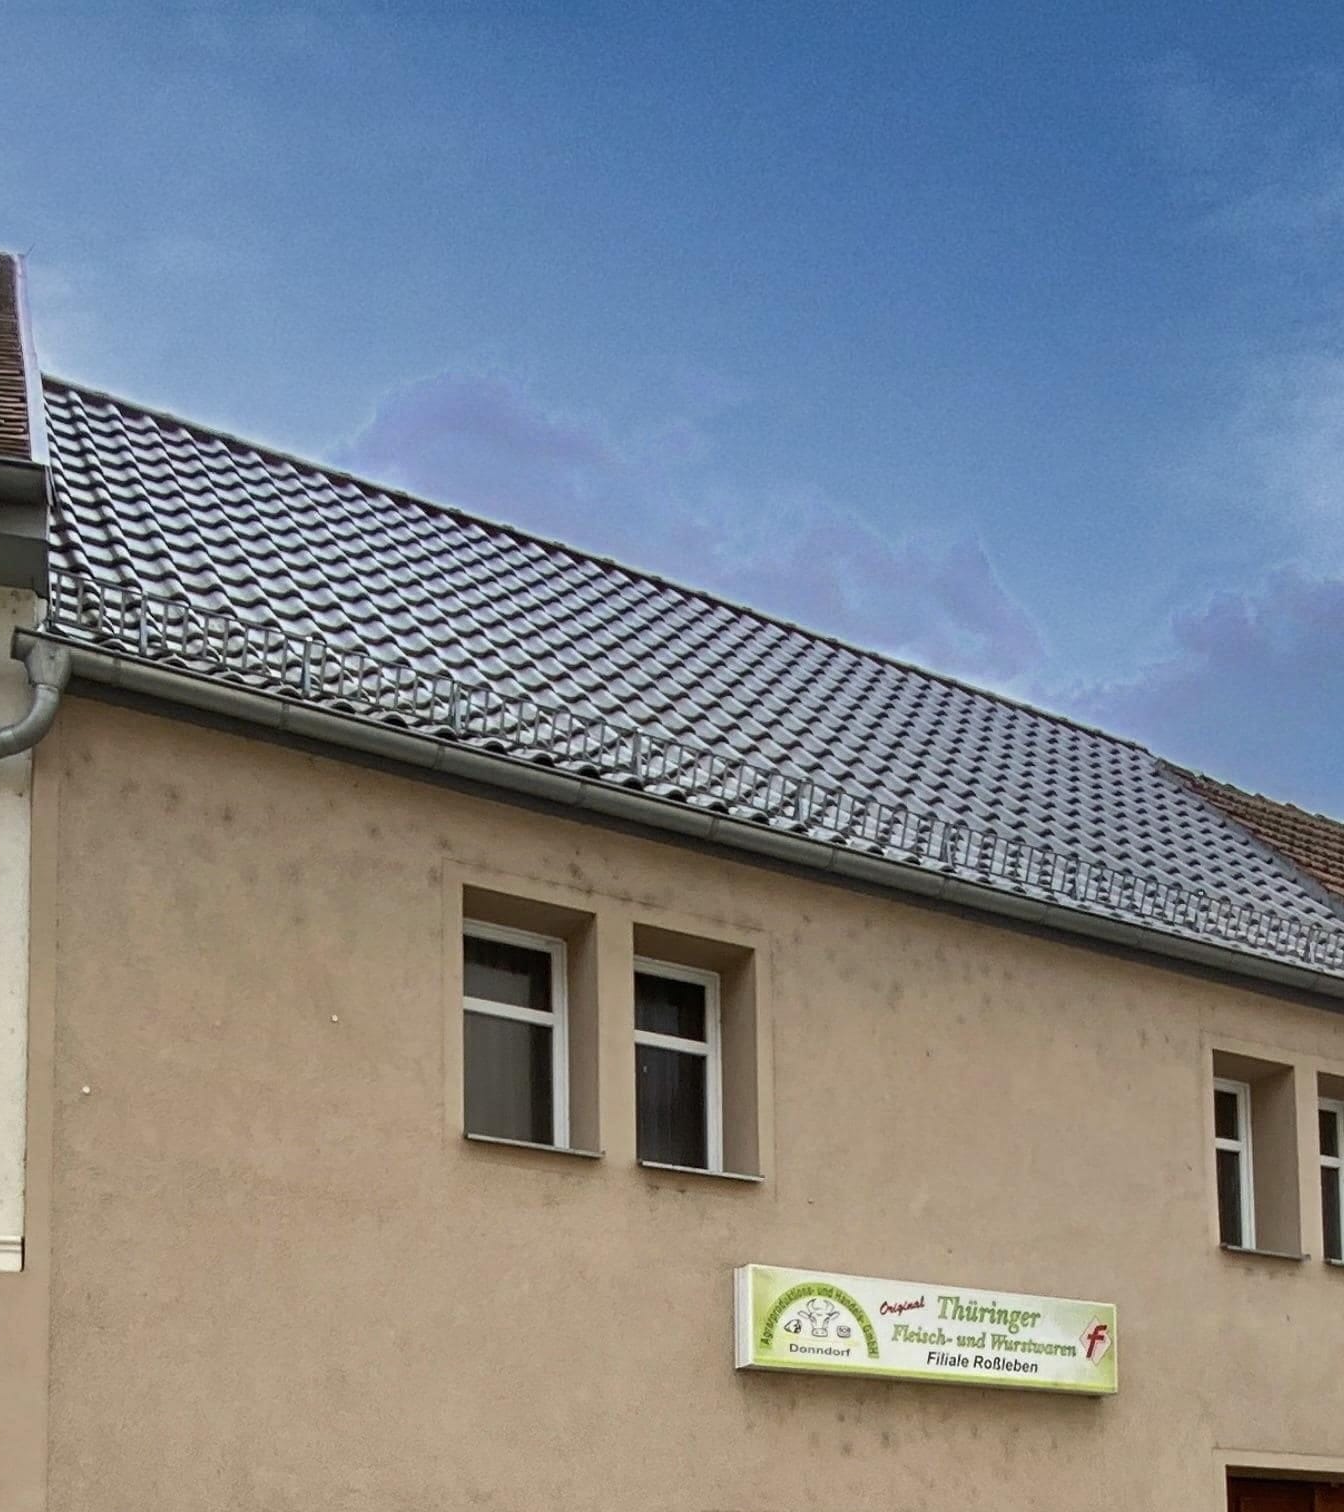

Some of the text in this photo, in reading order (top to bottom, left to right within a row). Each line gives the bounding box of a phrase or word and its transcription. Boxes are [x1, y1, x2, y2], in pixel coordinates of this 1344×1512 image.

[817, 1287, 834, 1297] und
[879, 1296, 925, 1316] Original
[937, 1296, 1041, 1334] Thüringer
[789, 1343, 851, 1357] Donndorf
[891, 1324, 1077, 1357] Fleisch- und Wurstwaren
[927, 1351, 1039, 1374] Filiale Roßleben
